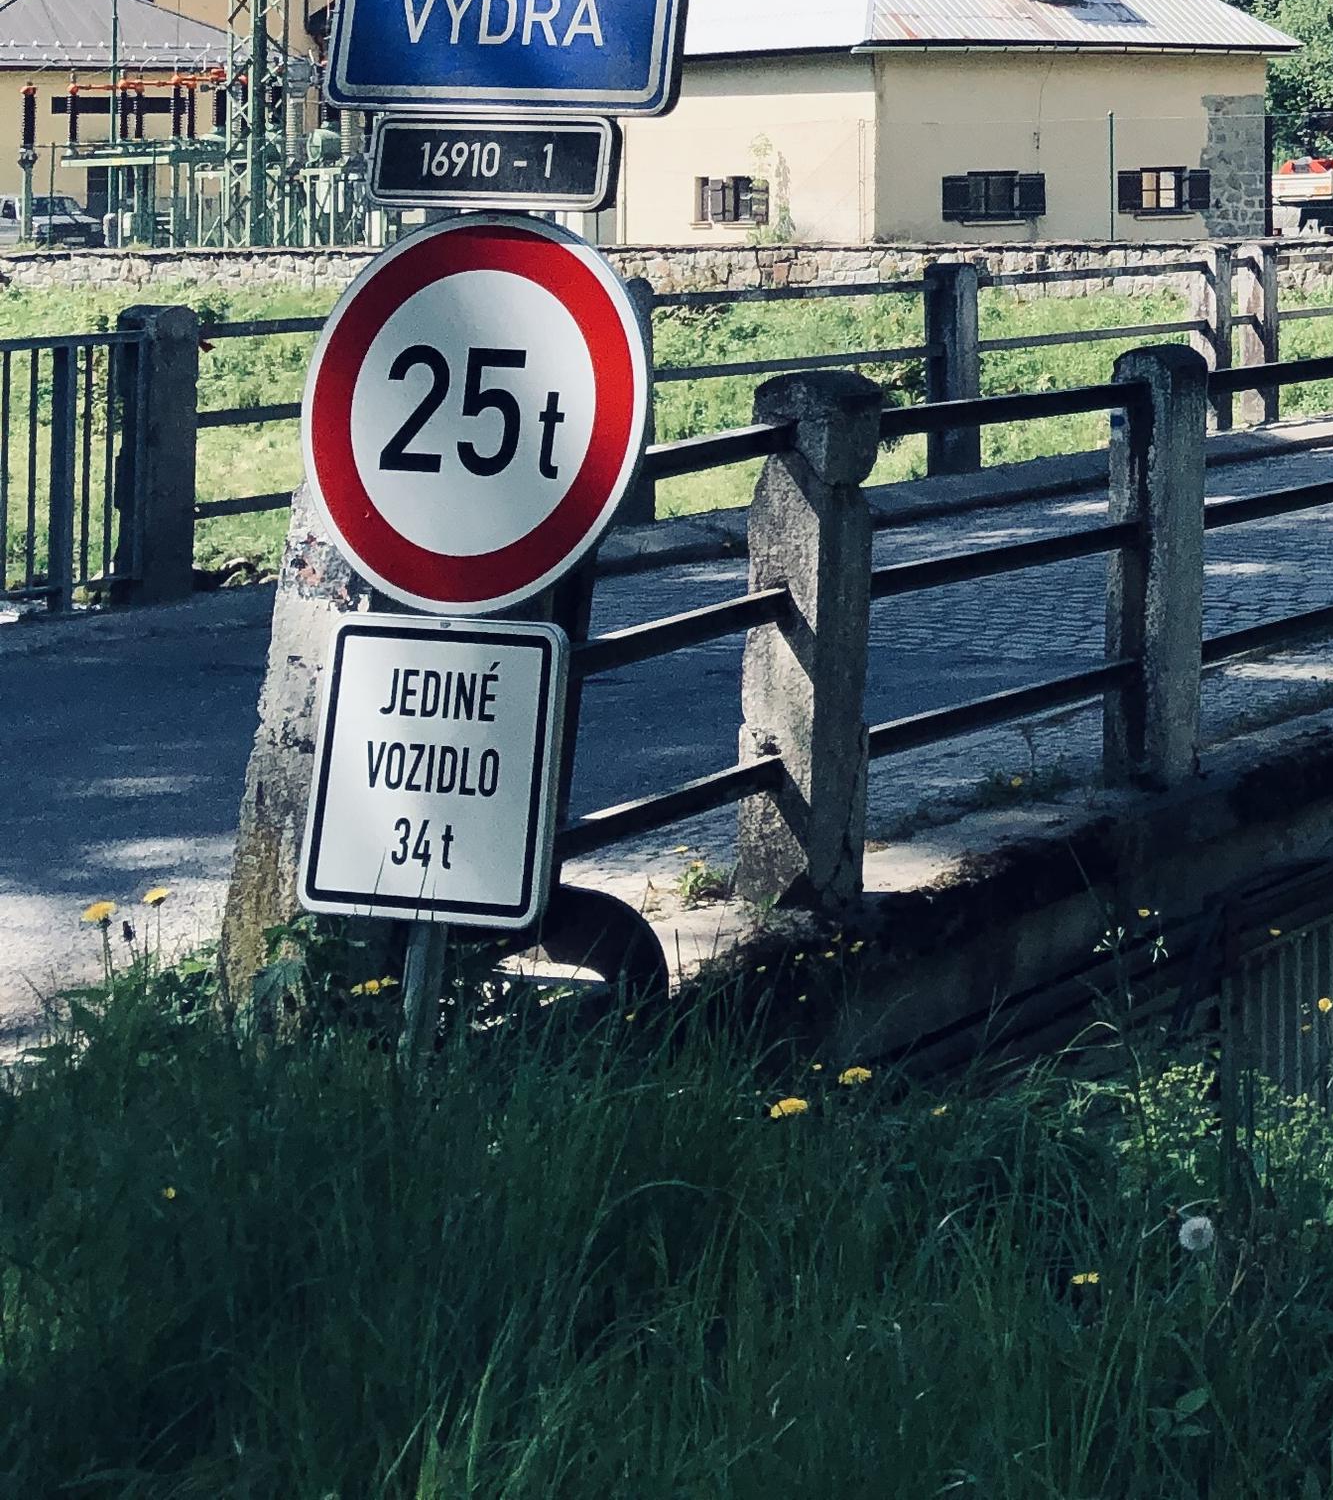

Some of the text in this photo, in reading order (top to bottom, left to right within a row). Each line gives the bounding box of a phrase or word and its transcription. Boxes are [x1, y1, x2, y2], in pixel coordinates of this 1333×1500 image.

[421, 141, 501, 177] 16910
[543, 143, 554, 179] 1
[379, 661, 501, 723] JEDINÉ
[367, 740, 500, 798] VOZIDLO
